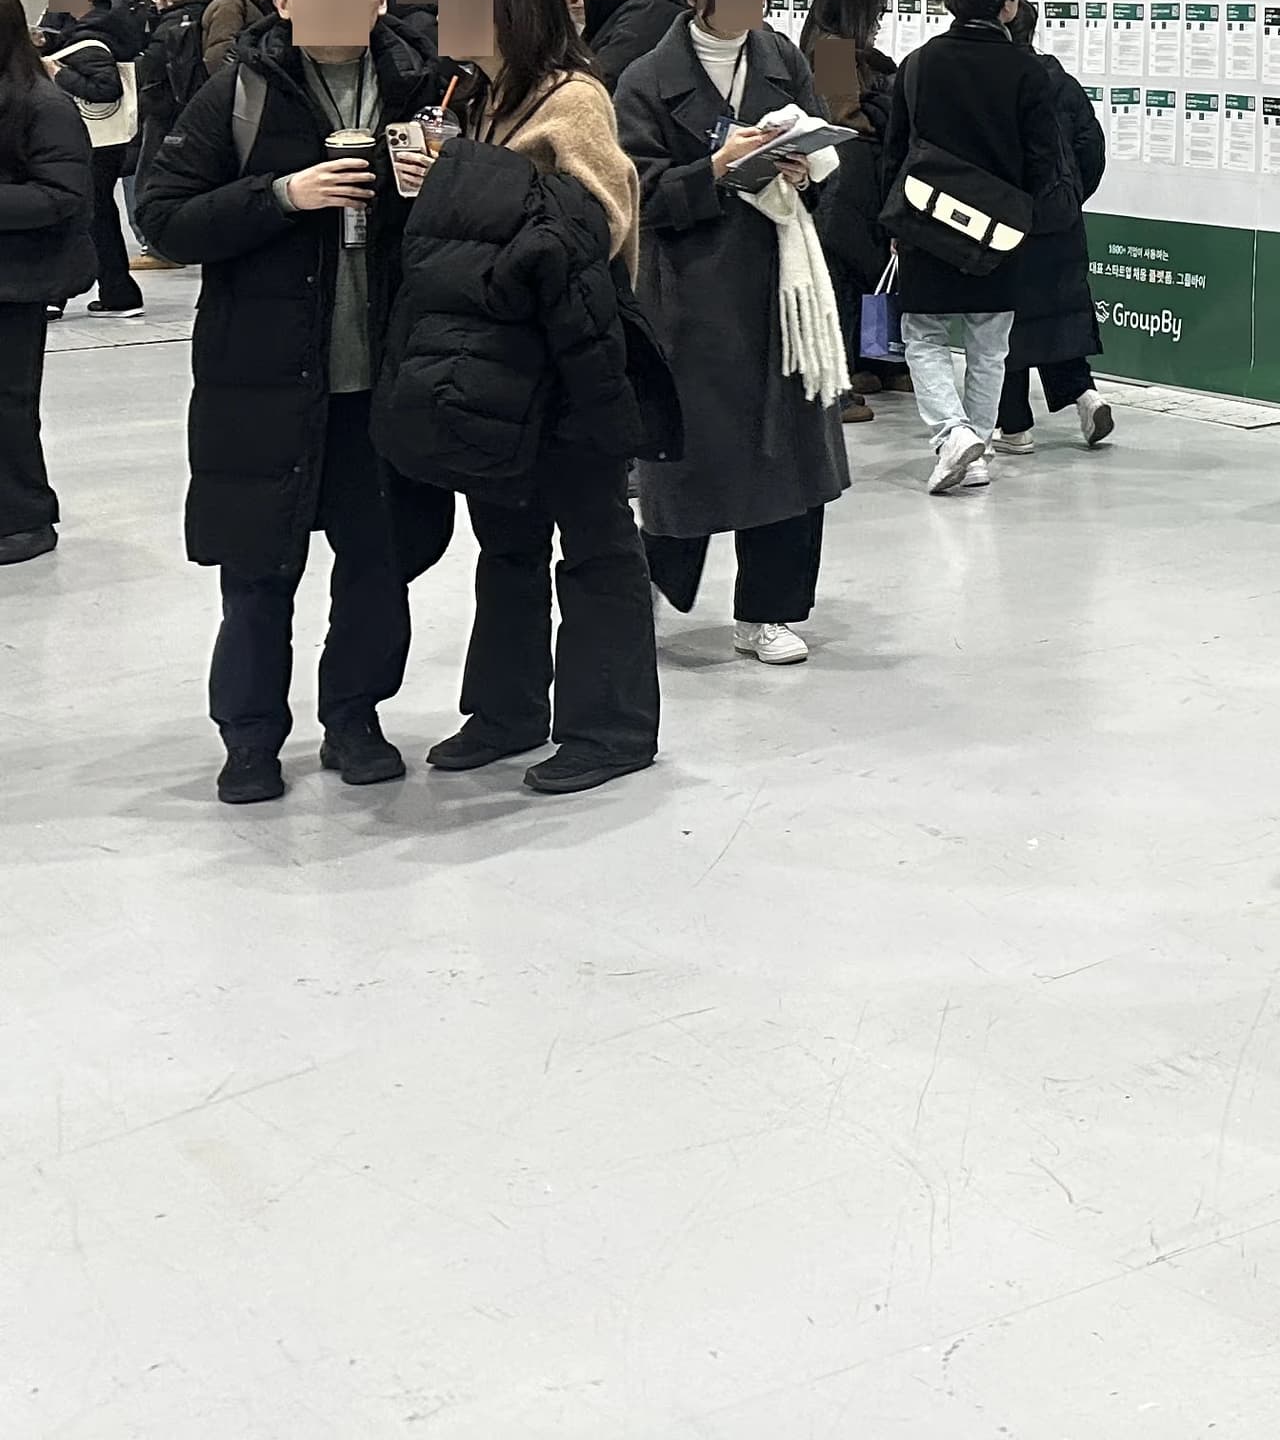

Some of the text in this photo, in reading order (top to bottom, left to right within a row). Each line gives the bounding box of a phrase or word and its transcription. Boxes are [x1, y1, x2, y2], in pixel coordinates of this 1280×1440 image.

[1089, 262, 1103, 274] 대표
[1105, 264, 1131, 279] 스타트업
[1176, 273, 1206, 288] 그룹바이
[1113, 303, 1181, 341] GroupBy
